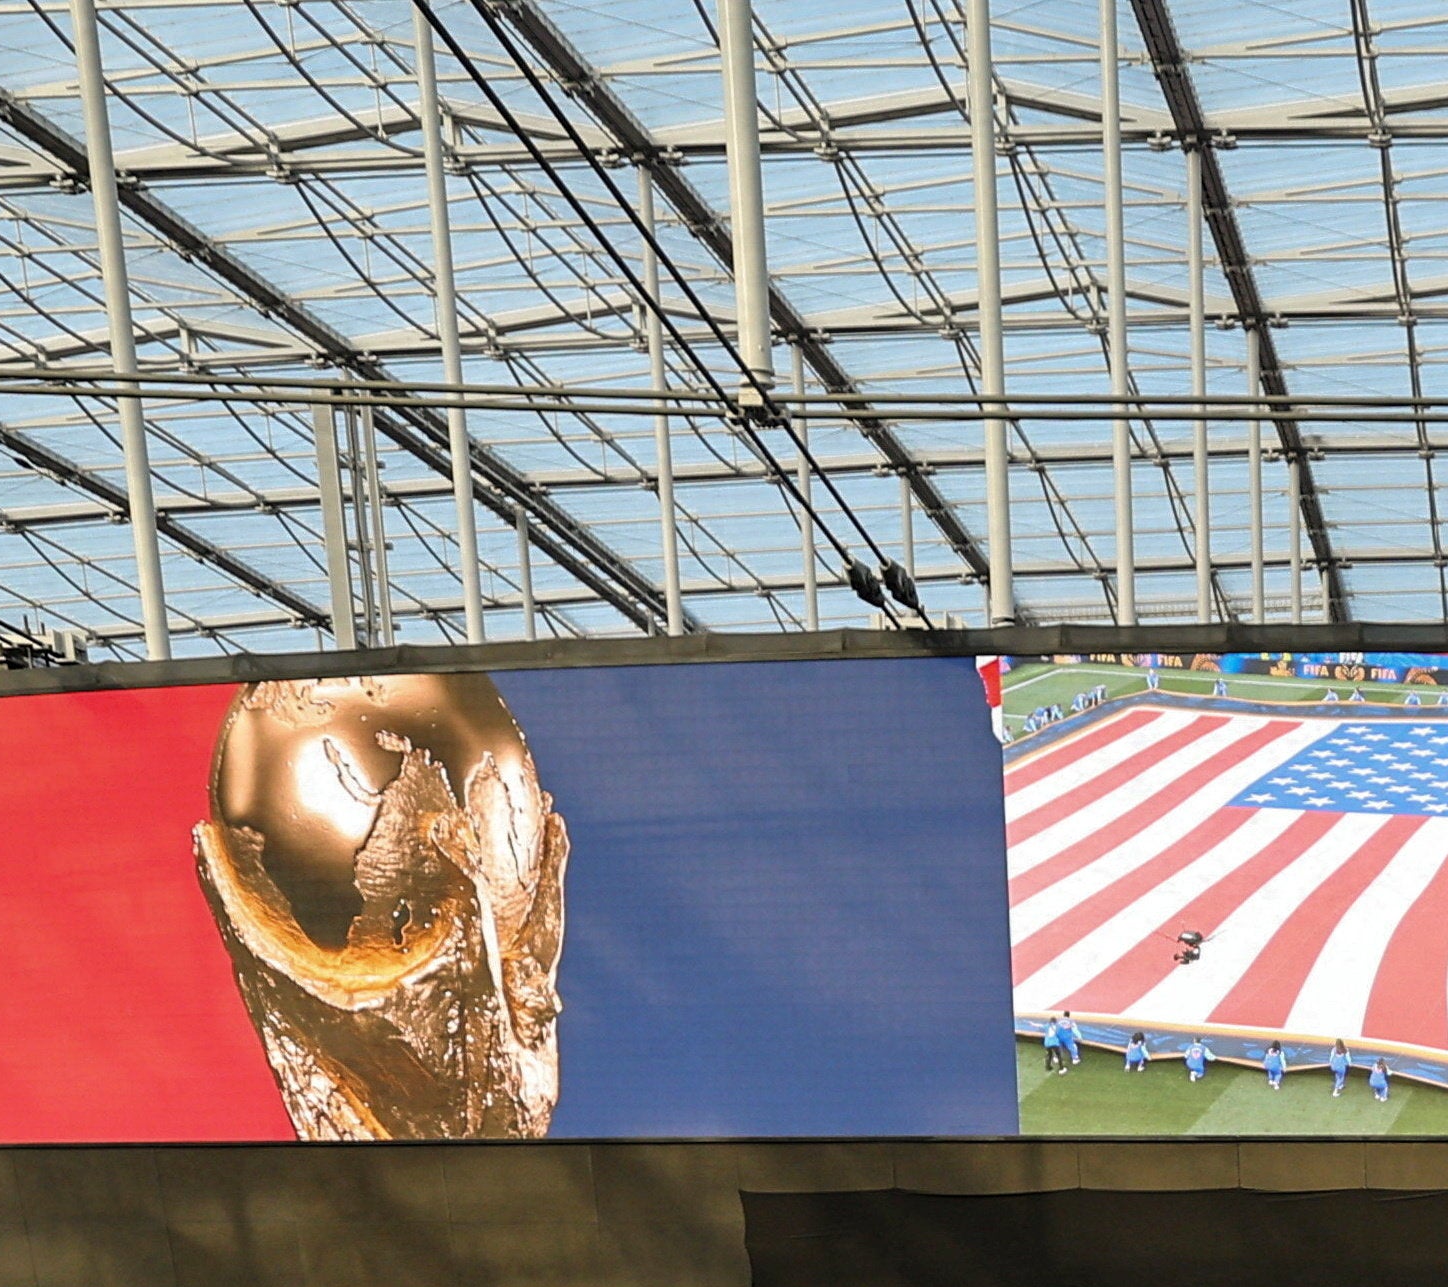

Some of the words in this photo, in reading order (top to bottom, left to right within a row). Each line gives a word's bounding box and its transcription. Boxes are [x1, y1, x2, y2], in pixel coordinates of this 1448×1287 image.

[1157, 655, 1182, 667] FIFA
[1303, 664, 1329, 678] FIFA
[1371, 667, 1397, 681] FIFA
